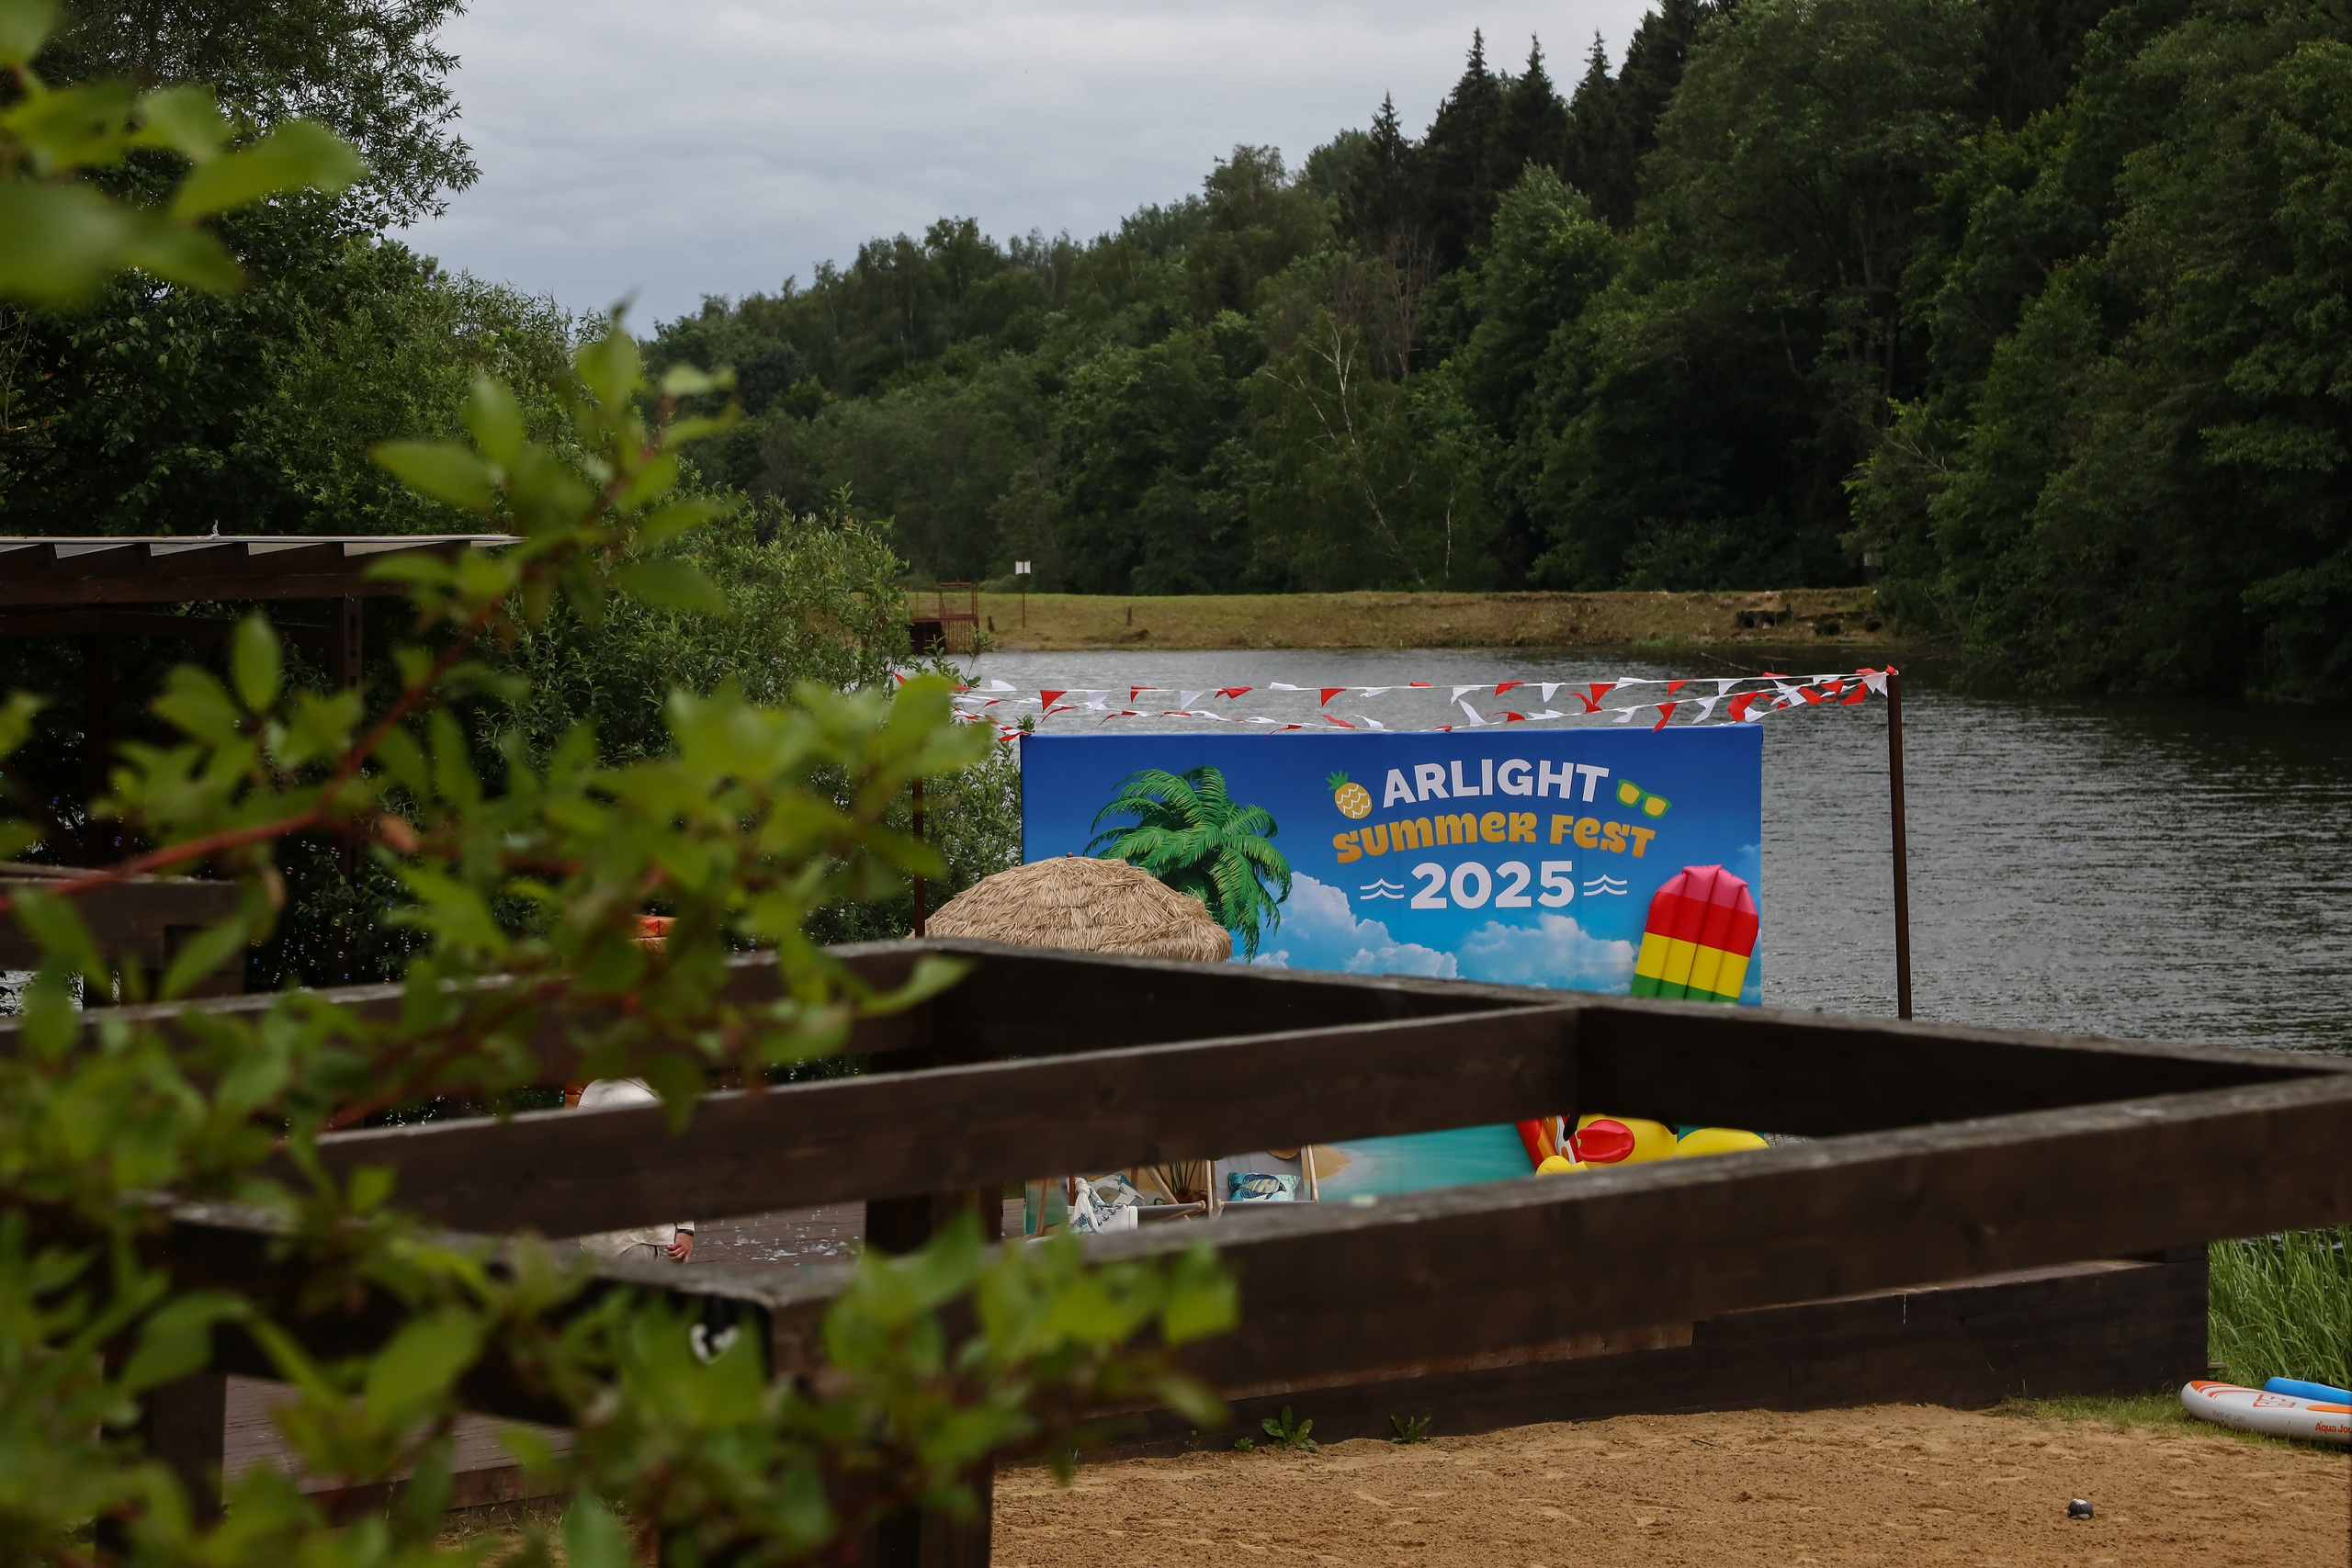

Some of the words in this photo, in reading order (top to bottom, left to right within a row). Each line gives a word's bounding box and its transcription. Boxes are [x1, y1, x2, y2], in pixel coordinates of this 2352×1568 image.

[1383, 759, 1610, 808] ARLIGHT
[1410, 860, 1576, 909] 2025
[2315, 1422, 2337, 1434] Aqua
